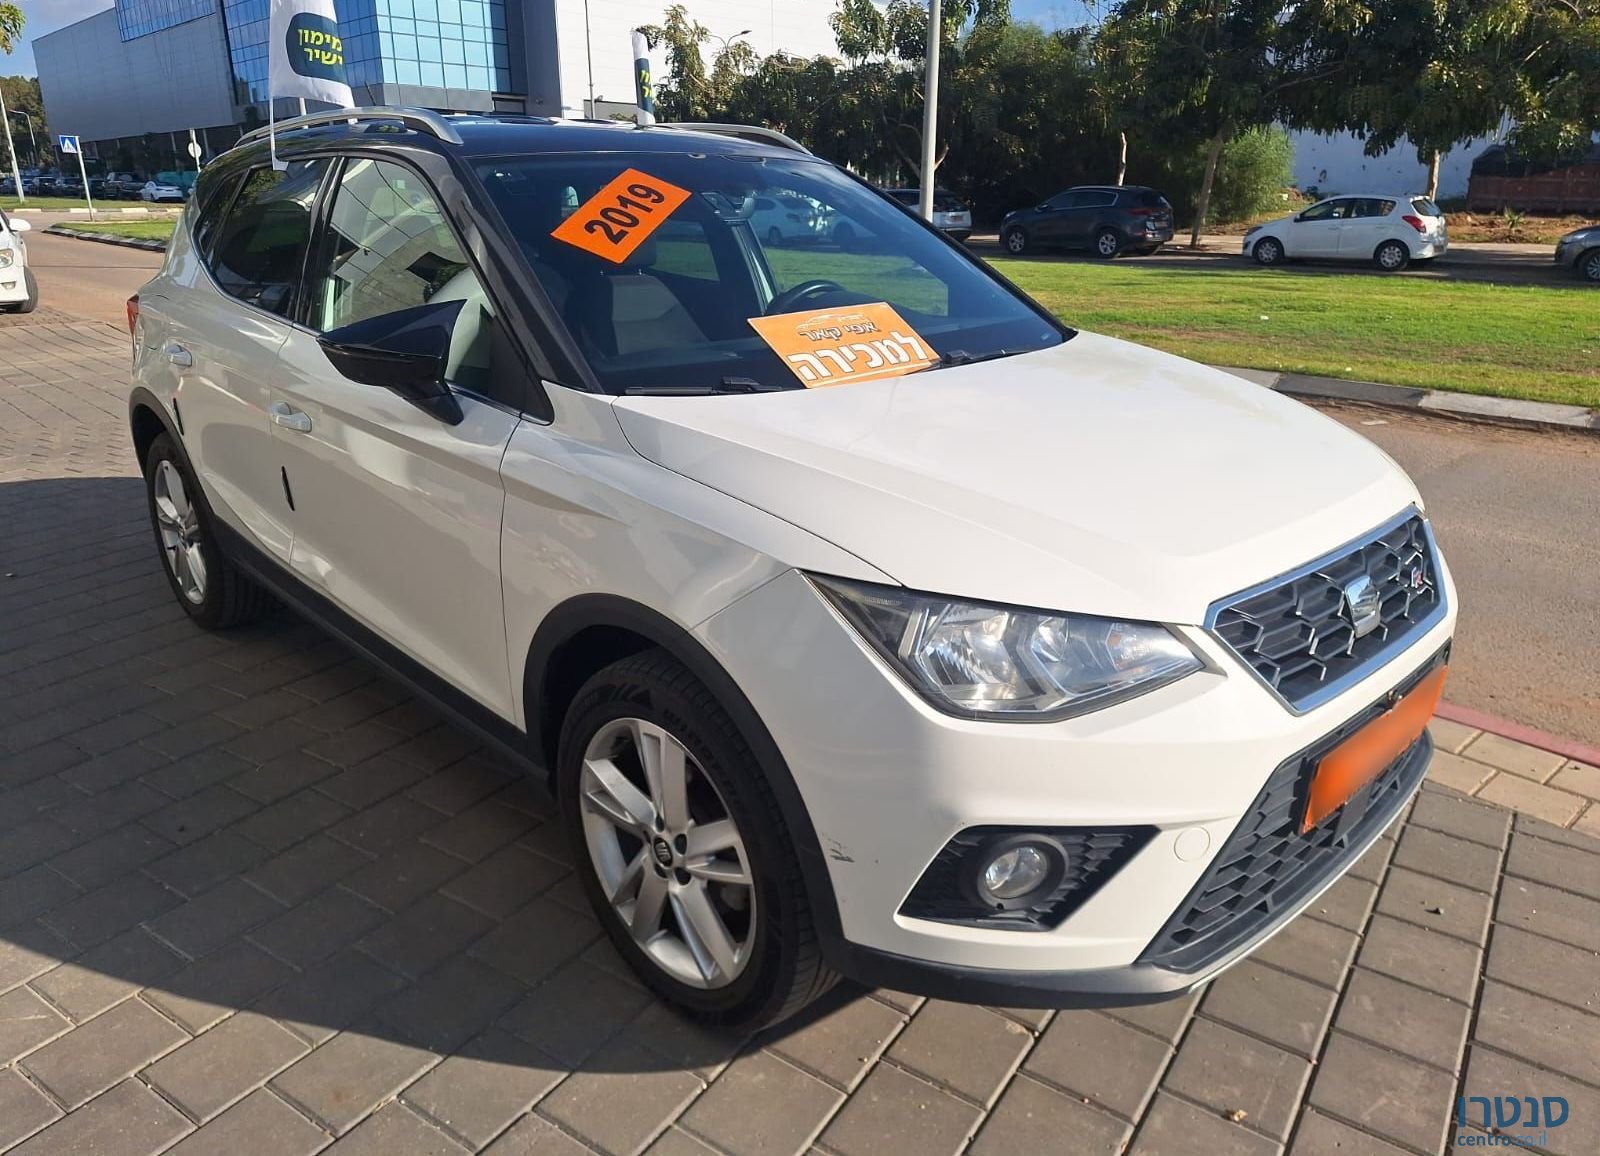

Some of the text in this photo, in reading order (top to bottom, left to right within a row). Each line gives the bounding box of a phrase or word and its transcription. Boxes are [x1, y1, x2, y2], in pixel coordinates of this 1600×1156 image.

[298, 28, 343, 52] מימון
[303, 47, 343, 65] ישיר
[584, 183, 665, 245] 2019
[787, 331, 929, 381] למכירה
